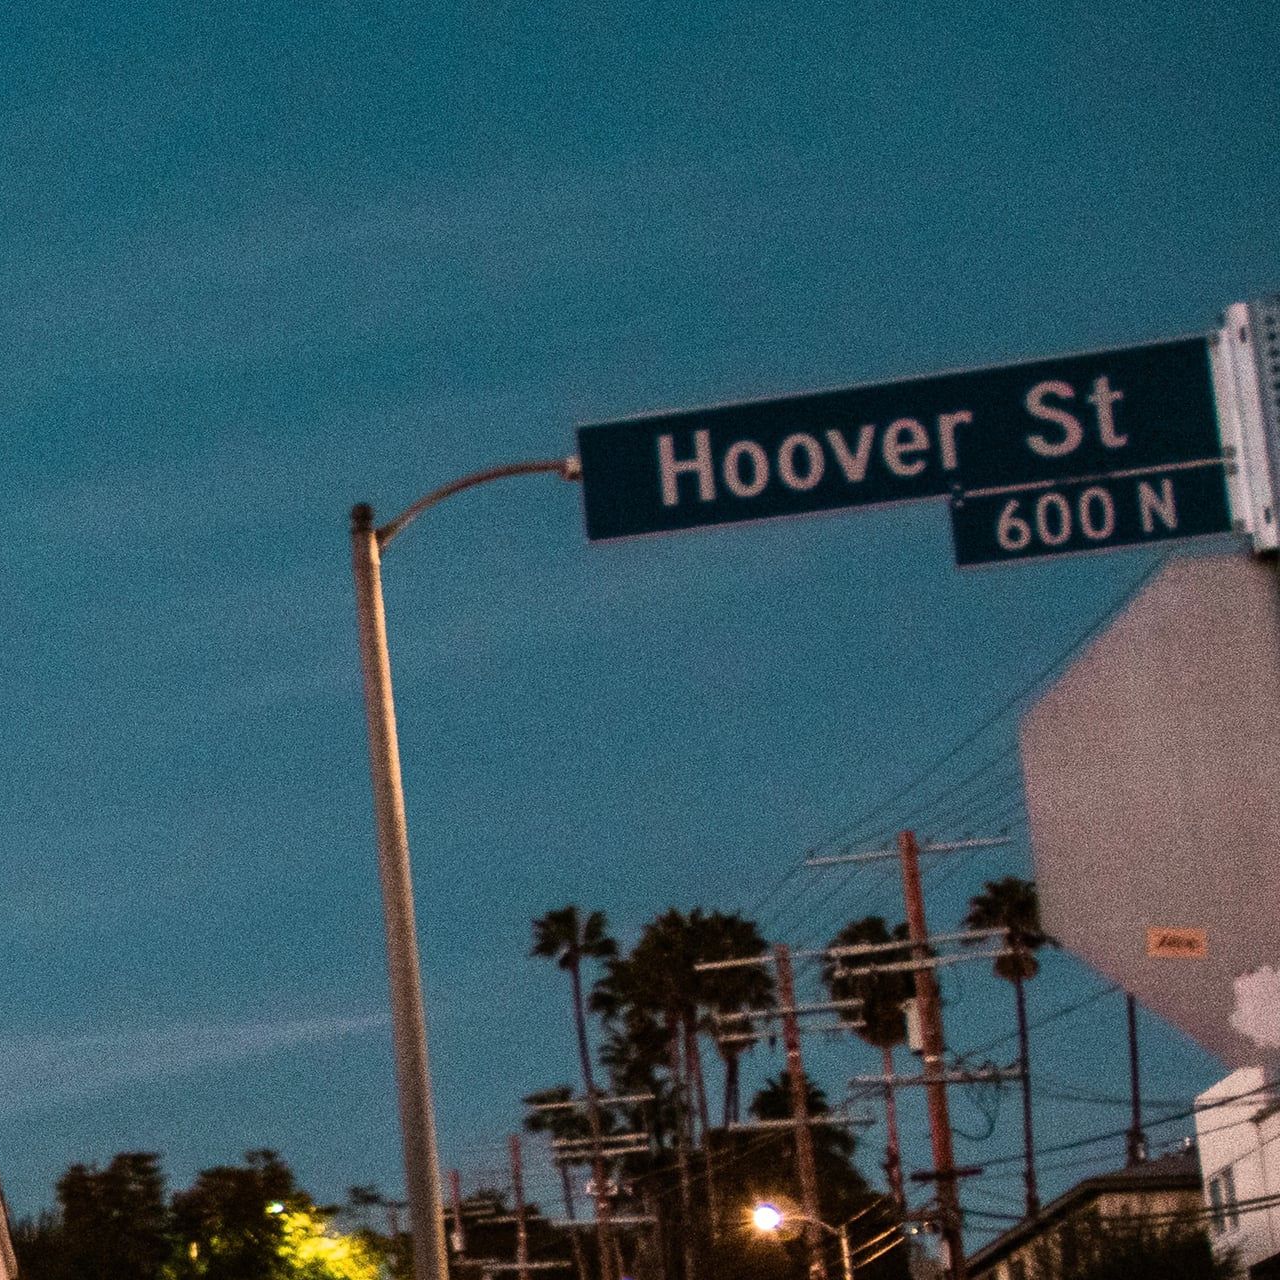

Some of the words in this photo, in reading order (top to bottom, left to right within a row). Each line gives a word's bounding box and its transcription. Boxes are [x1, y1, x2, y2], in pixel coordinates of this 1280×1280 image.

[656, 409, 973, 506] Hoover
[1025, 375, 1129, 458] St
[996, 486, 1117, 551] 600
[1139, 477, 1179, 533] N
